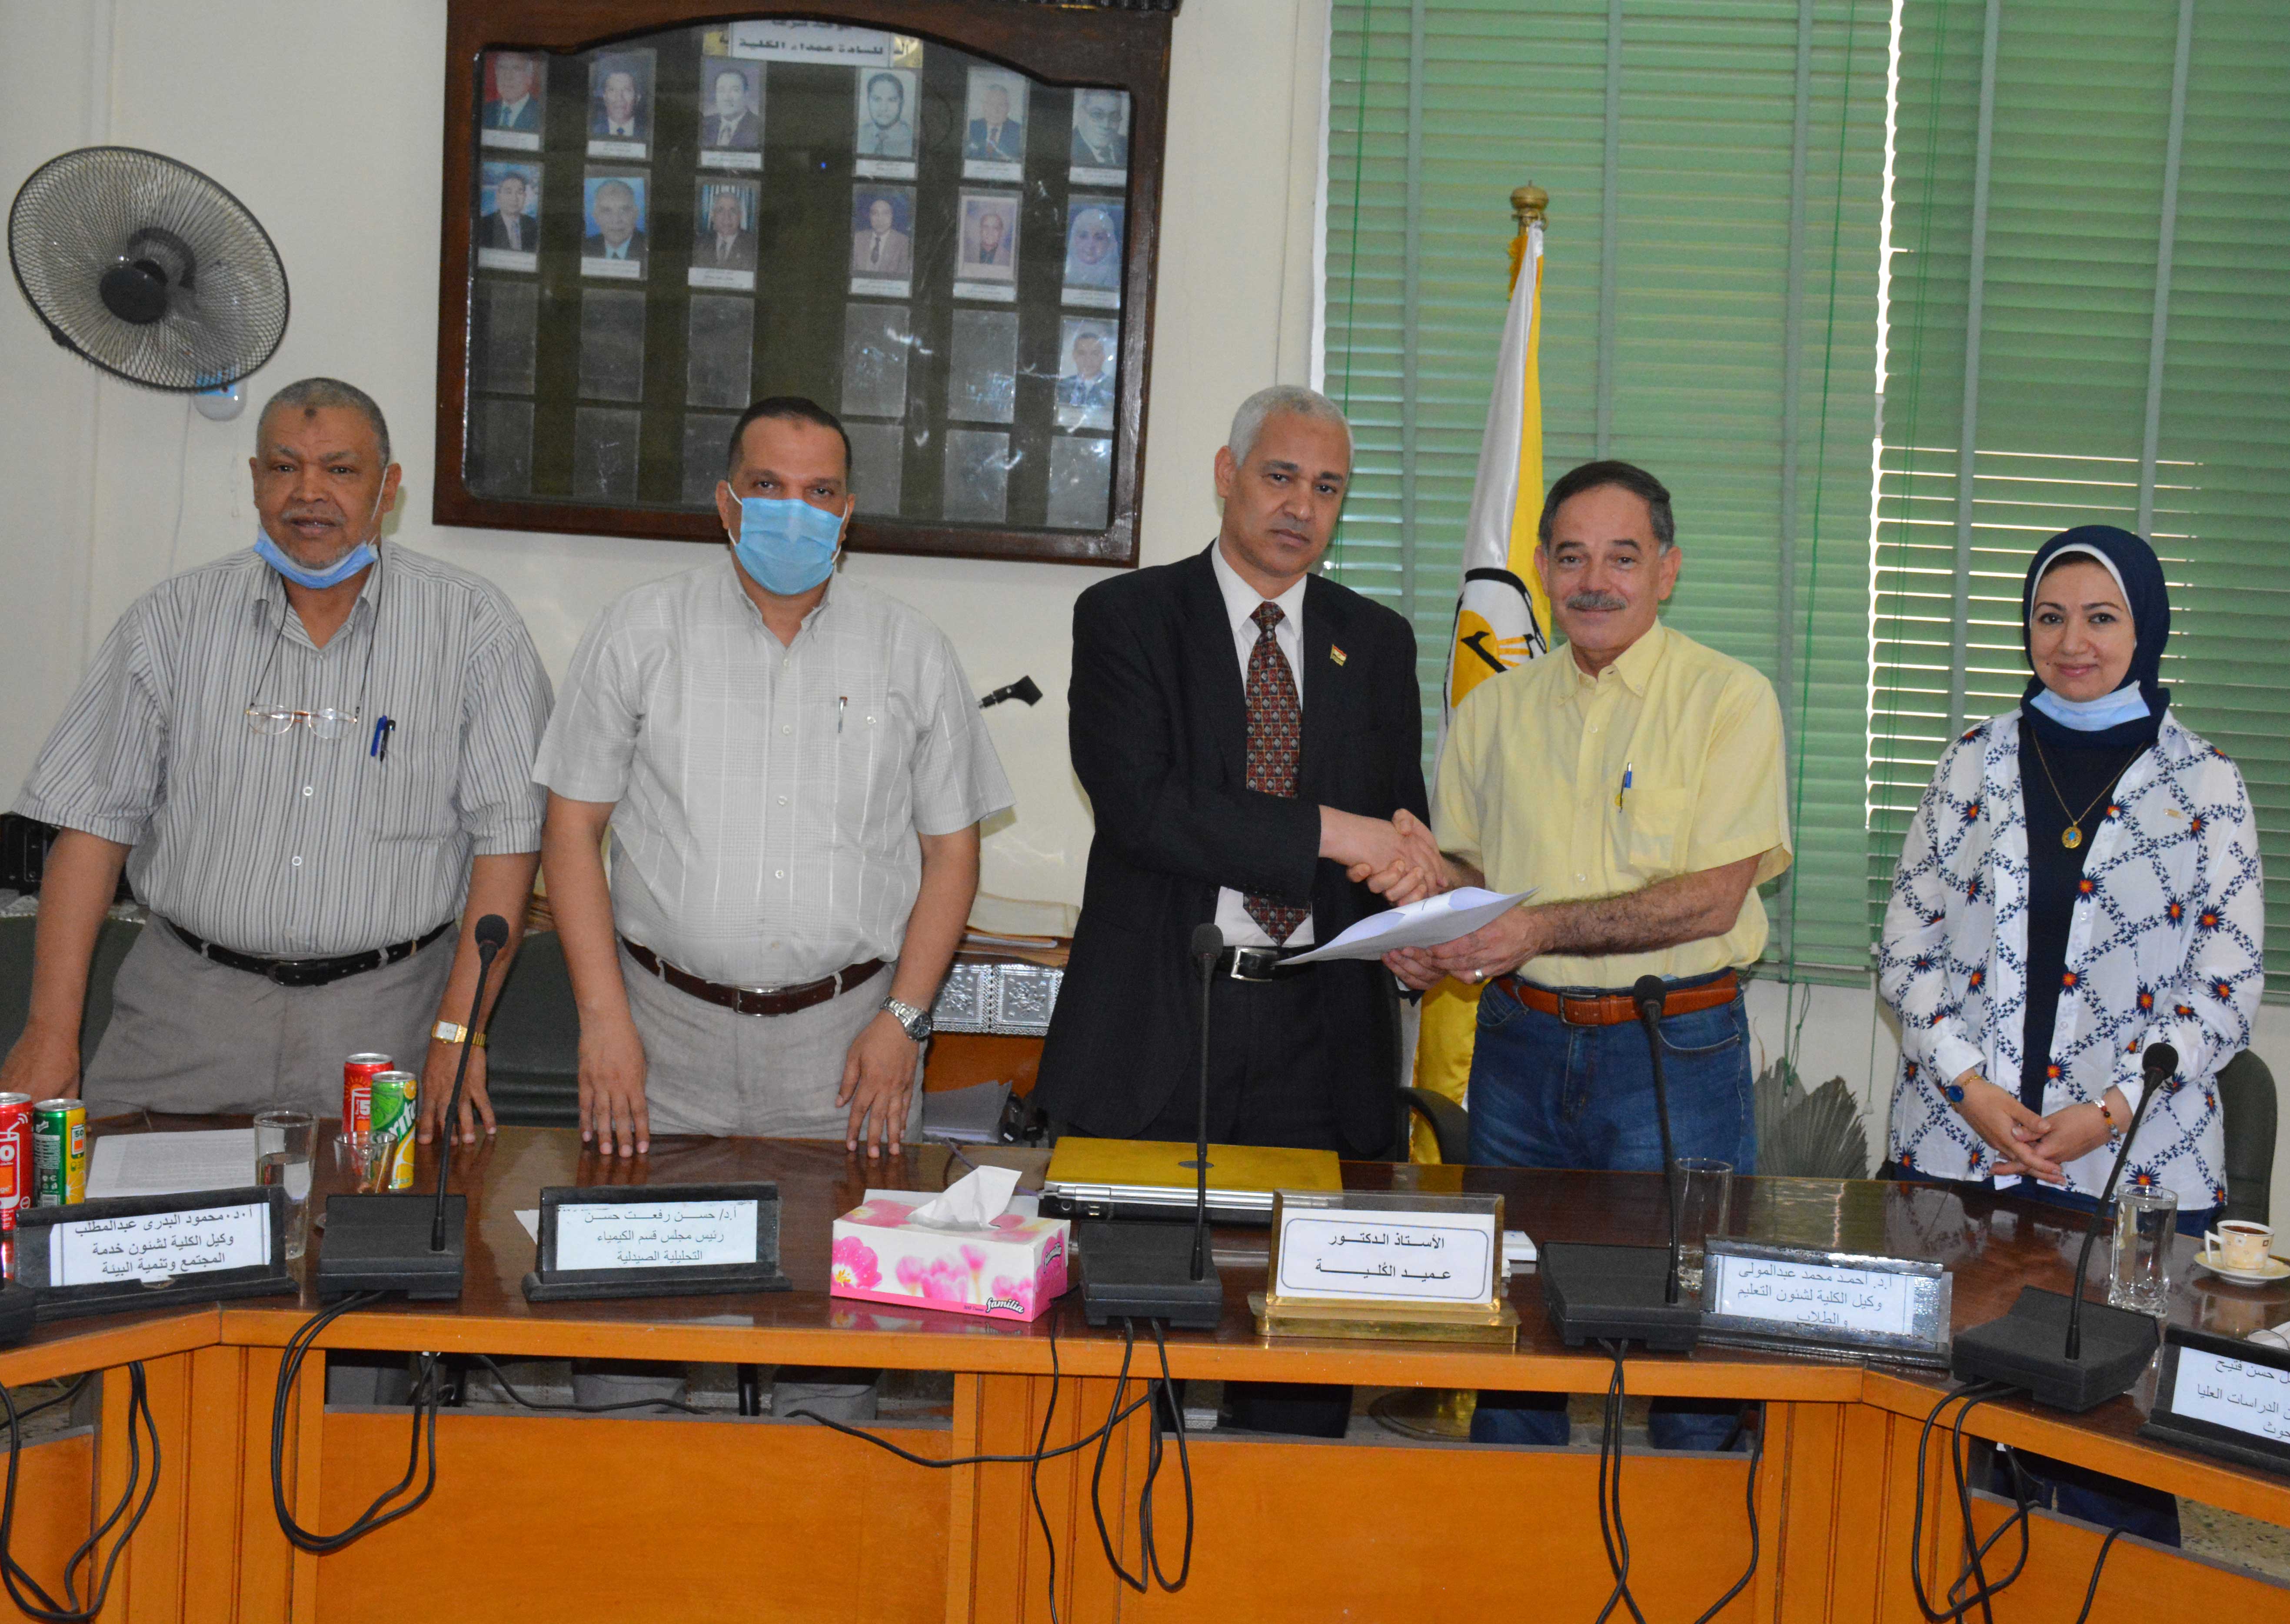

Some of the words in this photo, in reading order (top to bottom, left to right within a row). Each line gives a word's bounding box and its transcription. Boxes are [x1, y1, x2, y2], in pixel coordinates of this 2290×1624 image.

[143, 1214, 181, 1231] البدرى
[585, 1213, 620, 1223] حسن
[624, 1209, 670, 1222] رفعت
[674, 1211, 716, 1222] حسن
[171, 1235, 202, 1251] الكلية
[206, 1233, 234, 1247] وكيل
[597, 1230, 634, 1243] الكيمياء
[638, 1230, 657, 1245] قسم
[660, 1229, 692, 1243] مجلس
[695, 1230, 724, 1242] رئيس
[1328, 1233, 1389, 1246] الدكتور
[1394, 1232, 1445, 1249] الأستاذ
[92, 1242, 124, 1255] خدمة
[129, 1238, 167, 1255] لشئون
[180, 1252, 225, 1272] المجتمع
[617, 1250, 659, 1265] الصيدلية
[664, 1250, 702, 1263] التحليلية
[102, 1261, 133, 1277] البيئة
[137, 1258, 176, 1274] وتنمية
[1401, 1268, 1451, 1282] عميد
[1801, 1271, 1832, 1281] محمد
[1738, 1283, 1771, 1298] التعليم
[1776, 1289, 1813, 1302] لشئون
[1817, 1290, 1847, 1306] الكلية
[985, 1297, 1025, 1313] familia
[1852, 1293, 1882, 1311] وكيل
[2247, 1366, 2275, 1378] حسن
[2197, 1384, 2223, 1400] العليا
[2227, 1394, 2279, 1413] الدراسات
